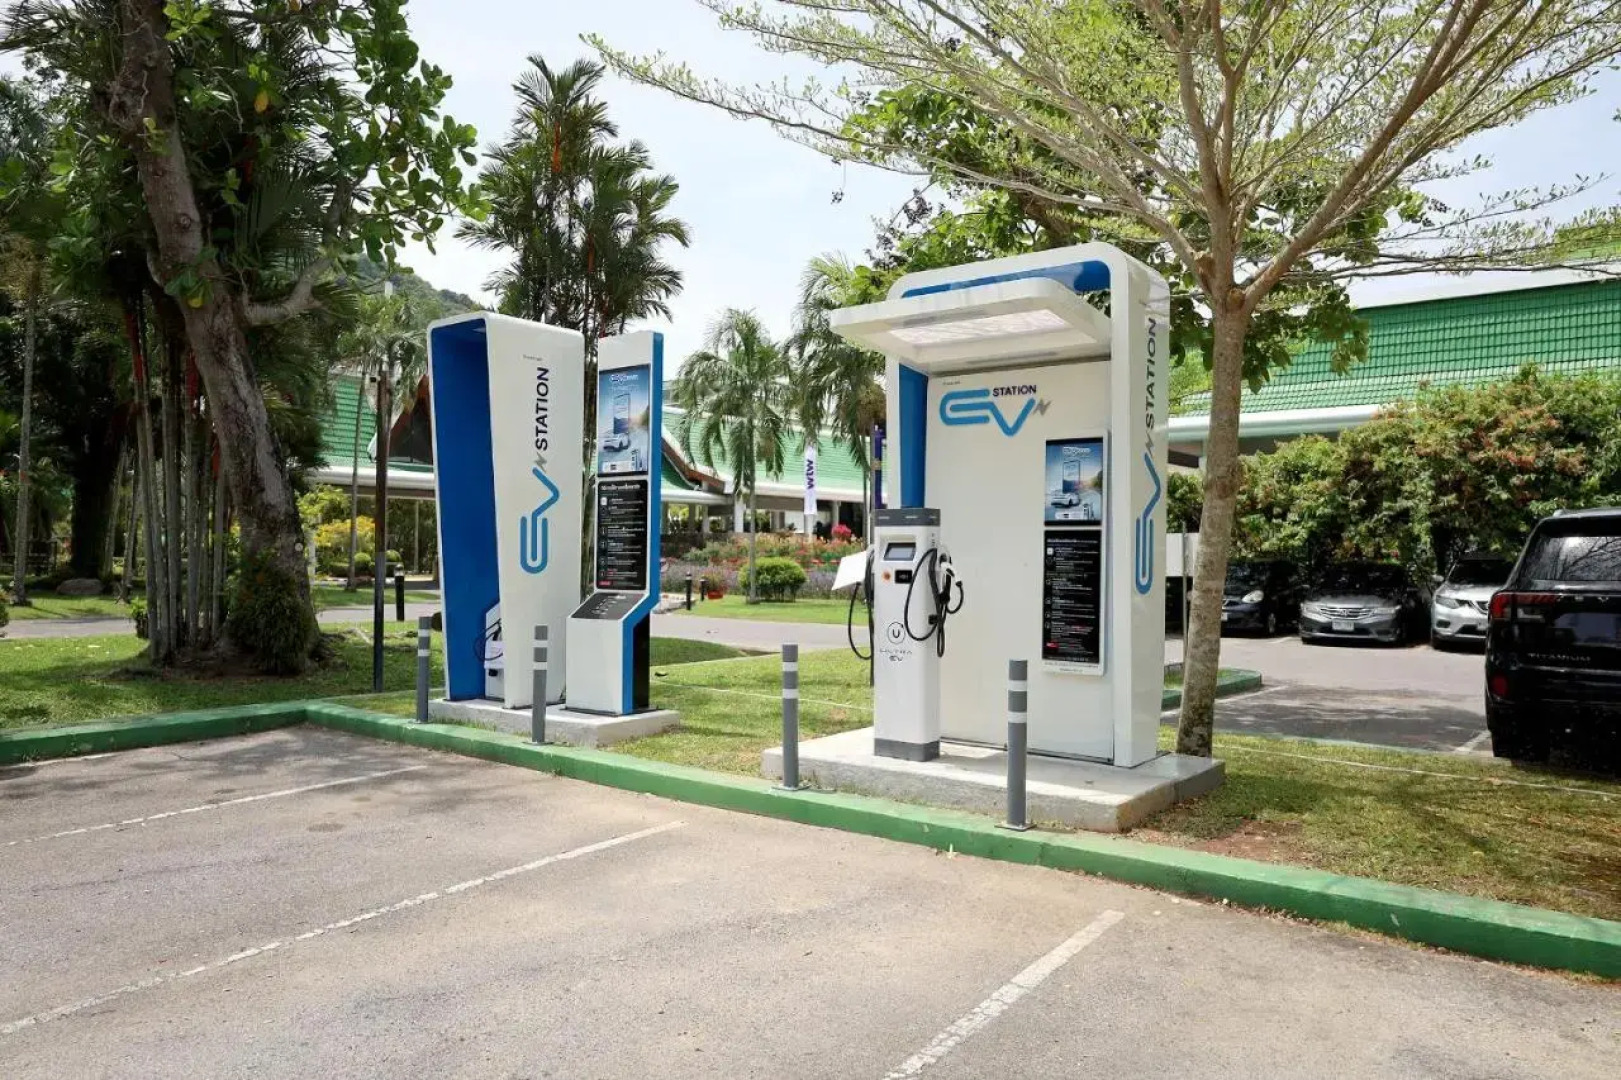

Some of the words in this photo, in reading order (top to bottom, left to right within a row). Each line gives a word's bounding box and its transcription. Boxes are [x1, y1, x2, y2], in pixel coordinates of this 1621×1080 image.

[1145, 317, 1157, 430] STATION
[992, 384, 1037, 397] STATION
[535, 366, 550, 452] STATION
[806, 459, 815, 490] wtw
[1527, 652, 1591, 662] TITANIUM
